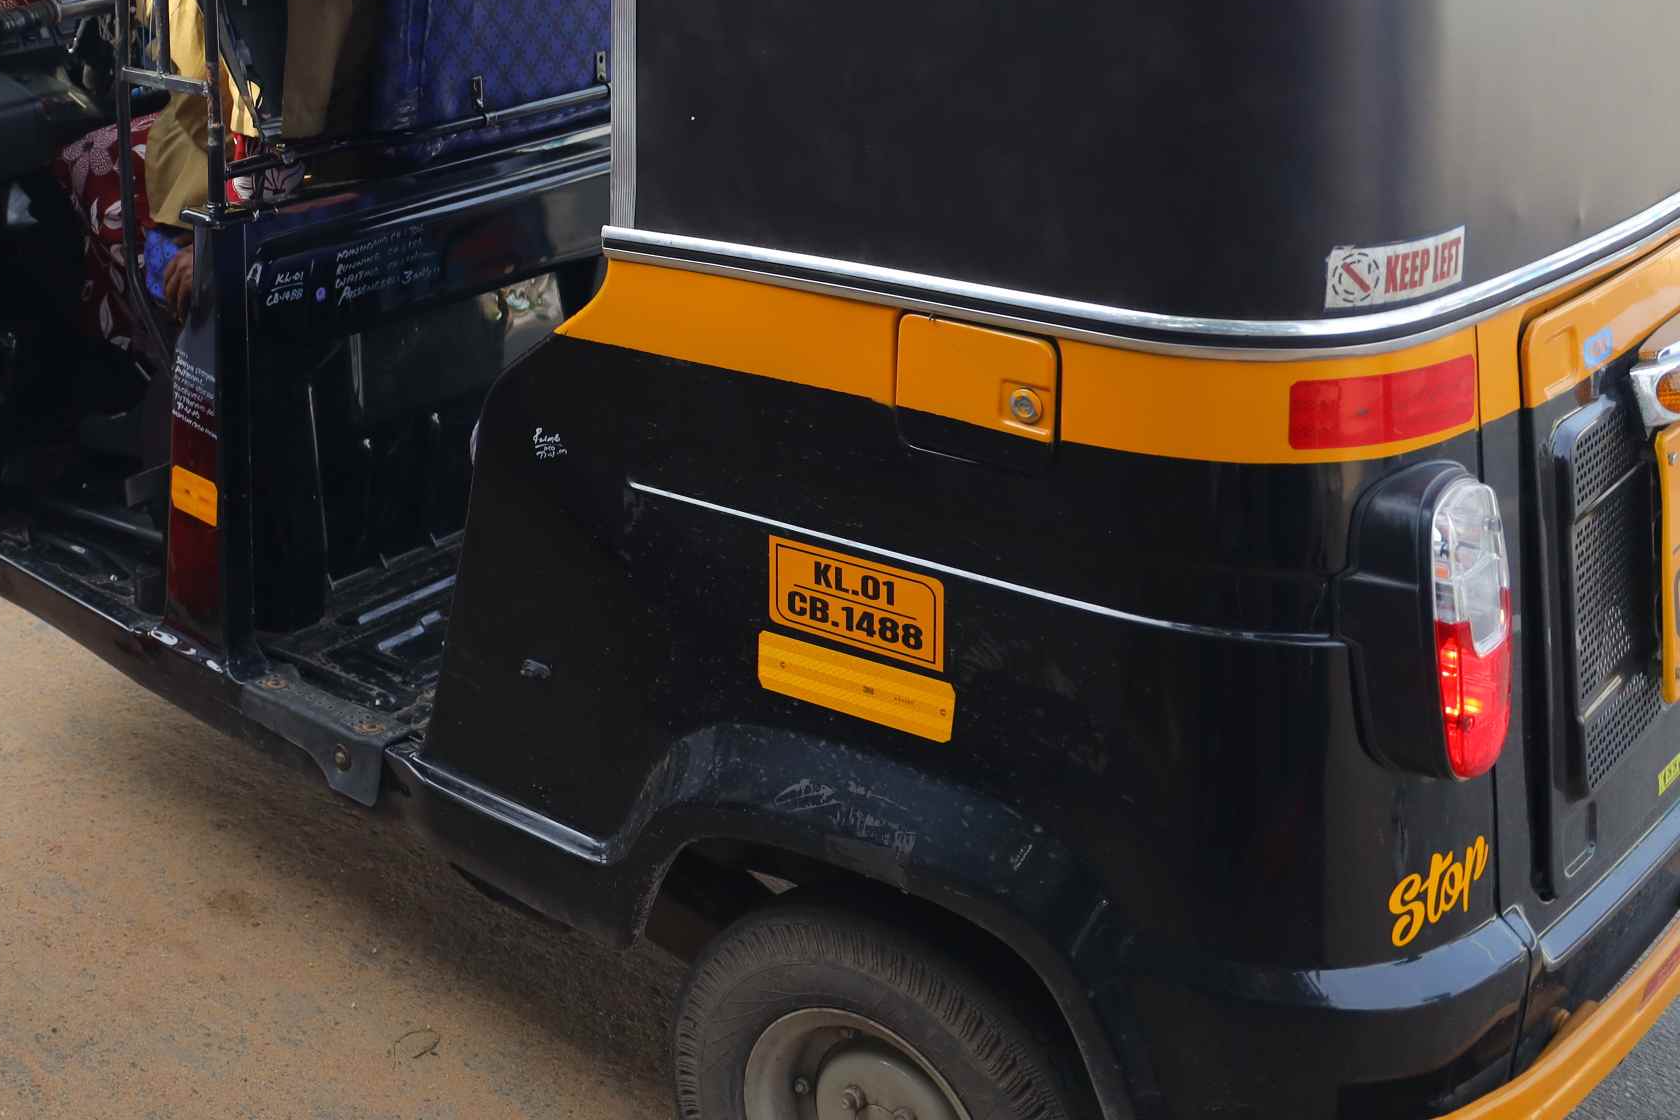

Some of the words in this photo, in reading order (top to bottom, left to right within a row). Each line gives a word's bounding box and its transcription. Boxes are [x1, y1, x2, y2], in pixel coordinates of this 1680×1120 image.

[1384, 248, 1430, 294] KEEP
[1432, 236, 1462, 283] LEFT
[814, 561, 895, 606] KL.01
[787, 591, 923, 650] CB.1488
[1389, 835, 1489, 947] Stop
